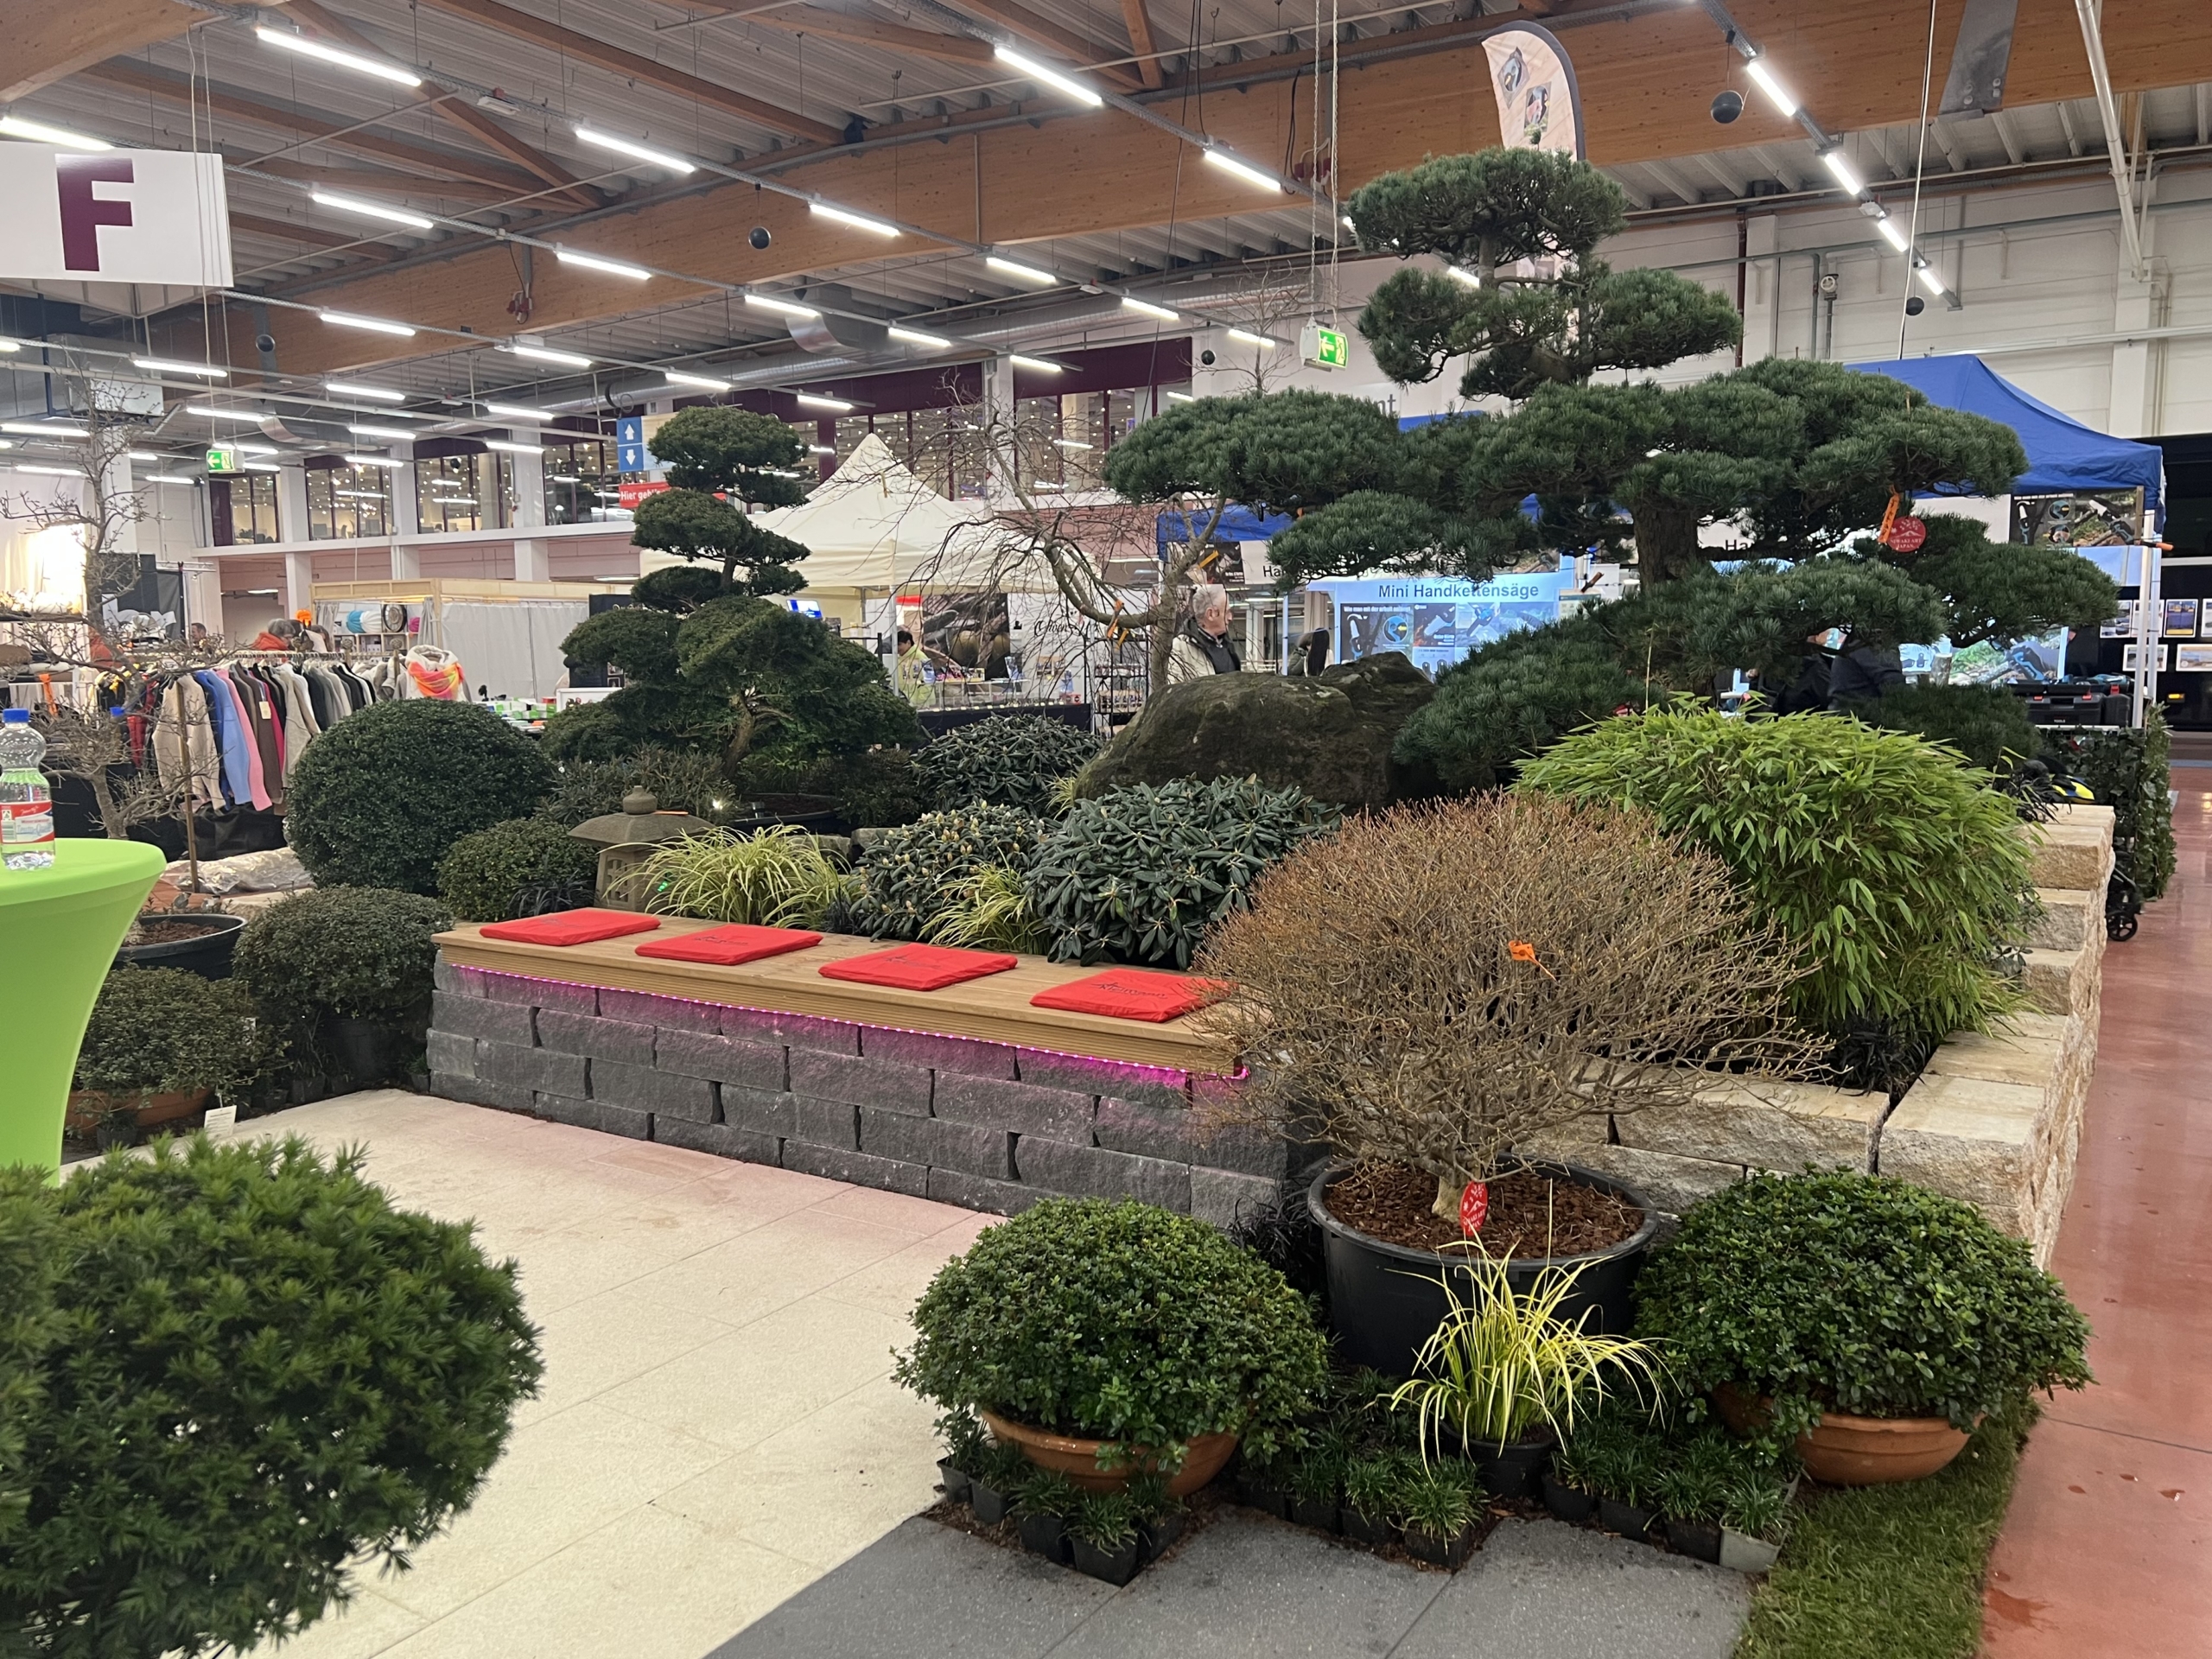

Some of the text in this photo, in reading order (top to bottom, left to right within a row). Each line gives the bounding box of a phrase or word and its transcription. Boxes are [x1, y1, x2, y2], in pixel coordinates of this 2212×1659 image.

[54, 154, 134, 271] F
[620, 490, 637, 501] Hier
[1379, 585, 1408, 598] Mini
